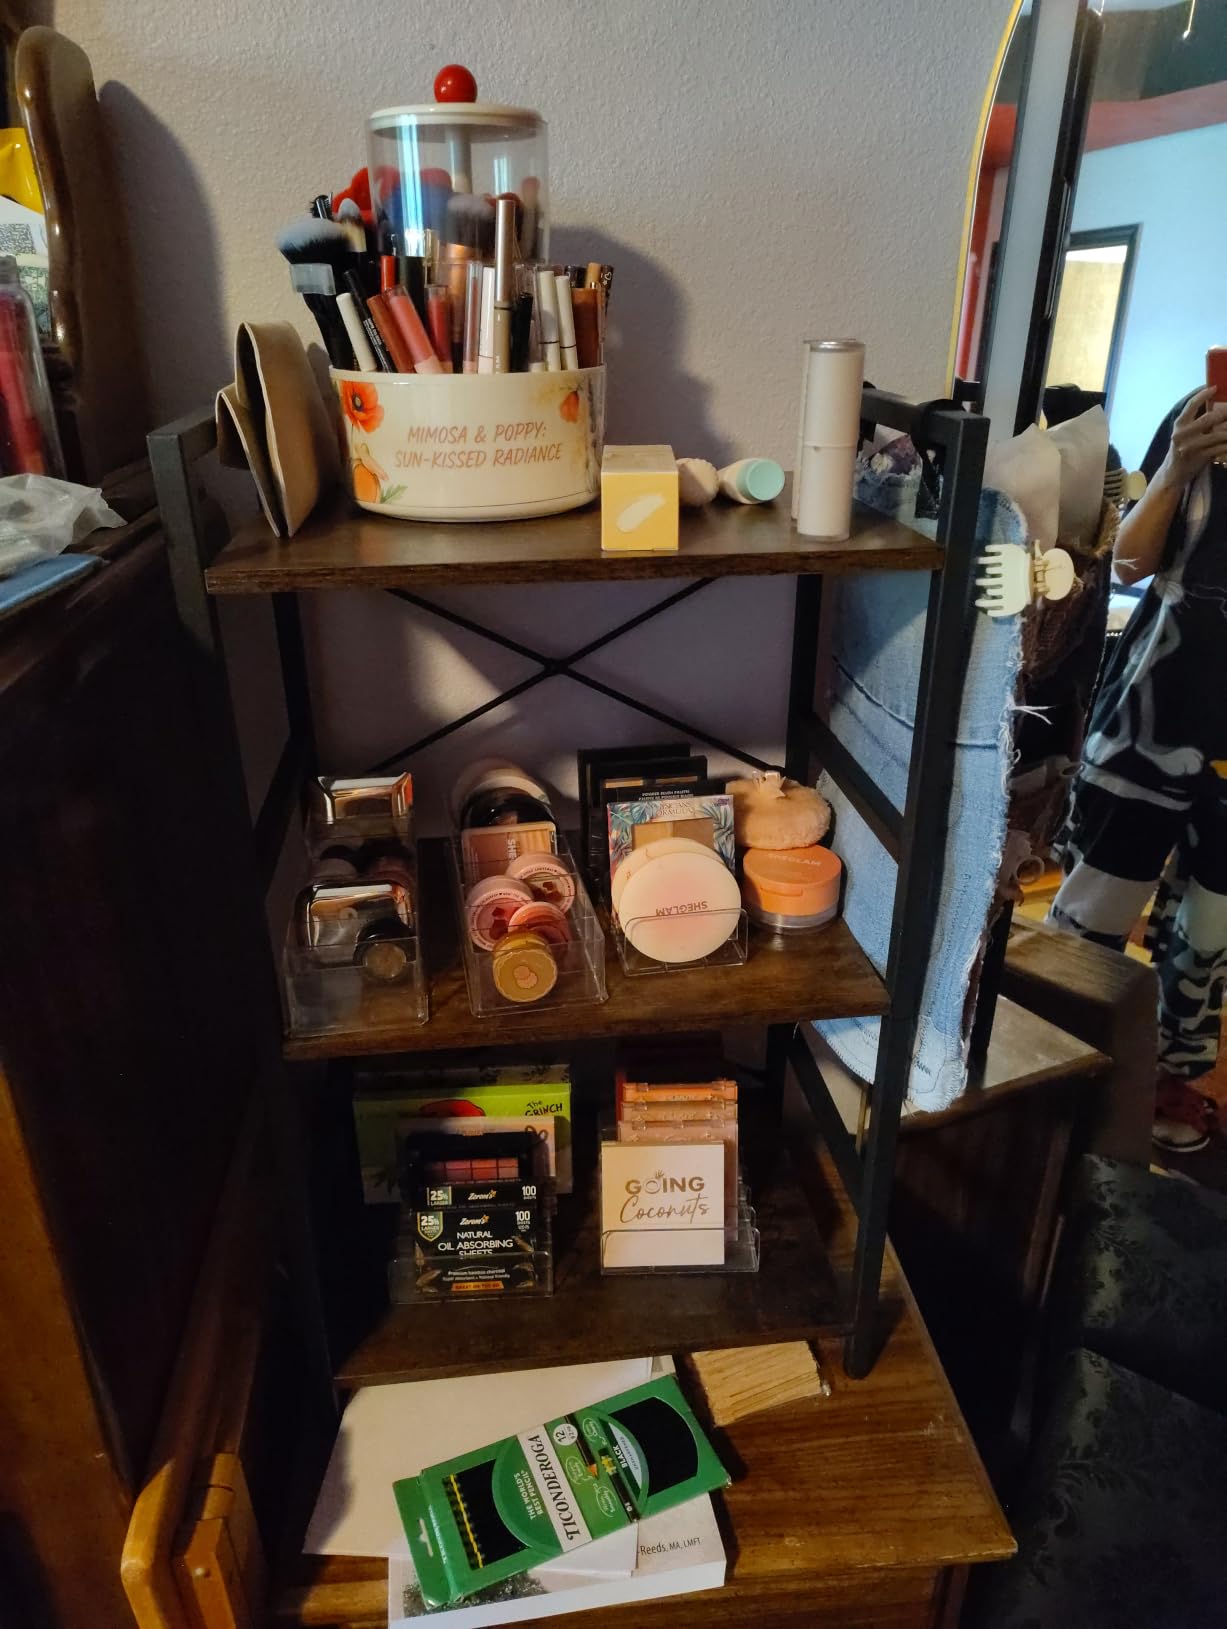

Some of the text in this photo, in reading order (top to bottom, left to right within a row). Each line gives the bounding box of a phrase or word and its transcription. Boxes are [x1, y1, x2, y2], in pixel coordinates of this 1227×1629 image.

[407, 421, 547, 444] MIMOSA & POPPY:
[394, 442, 563, 469] SUN-KISSED RADIANCE
[655, 900, 708, 917] SHEGLAM
[525, 1102, 563, 1117] GRINCH
[526, 1100, 542, 1109] The
[521, 1185, 537, 1196] 100
[624, 1174, 705, 1195] GOING
[515, 1210, 531, 1220] 100
[619, 1194, 710, 1224] Coconuts
[456, 1230, 493, 1240] NATURAL
[437, 1239, 514, 1252] OIL ABSORBING
[555, 1430, 567, 1443] 12
[612, 1444, 628, 1469] BLACK
[513, 1472, 537, 1520] THE WORLD'S
[527, 1435, 581, 1541] TICONDEROGA
[532, 1497, 544, 1516] BEST
[684, 1537, 701, 1548] LMFT
